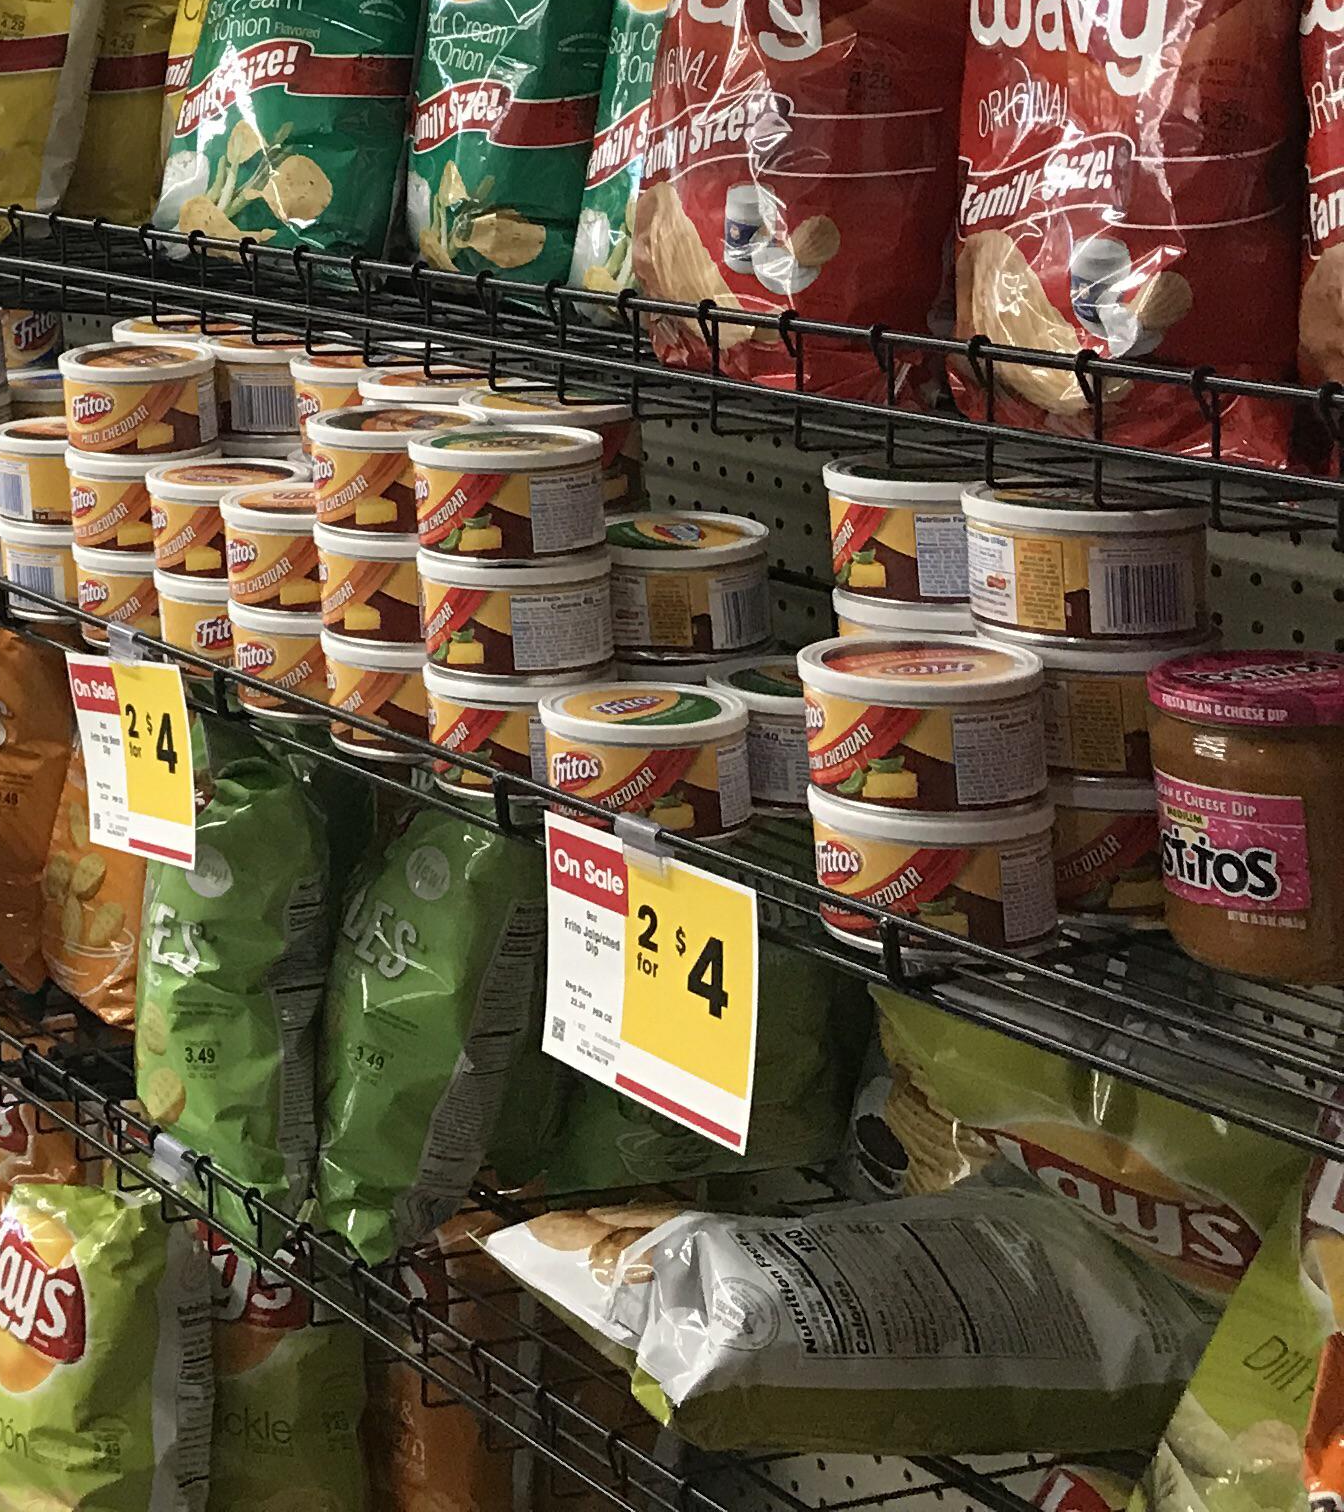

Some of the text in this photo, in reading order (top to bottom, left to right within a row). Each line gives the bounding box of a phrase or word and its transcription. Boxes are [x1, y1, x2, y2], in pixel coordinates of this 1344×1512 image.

[452, 14, 508, 46] Cream
[436, 37, 485, 73] Onion
[977, 85, 1071, 138] ORIGINAL
[960, 168, 1041, 228] Family
[72, 392, 112, 420] Fritos
[101, 404, 151, 443] CHEDDAR
[429, 487, 468, 529] CHEDDAR
[246, 556, 293, 593] CHEDDAR
[195, 619, 233, 647] Frit
[73, 677, 116, 702] On Sale
[125, 703, 140, 739] 2
[1185, 697, 1213, 716] BEAN
[1224, 703, 1265, 722] CHEESE
[1266, 707, 1289, 722] DIP
[128, 740, 143, 759] for
[824, 722, 874, 770] CHEDDAR
[553, 752, 600, 781] Fritos
[1184, 790, 1257, 818] CHEESE DIP
[553, 848, 626, 896] On Sale
[815, 839, 861, 876] Fritos
[637, 904, 659, 954] 2
[585, 940, 600, 959] Dip
[636, 951, 660, 979] for
[784, 1228, 818, 1254] 150
